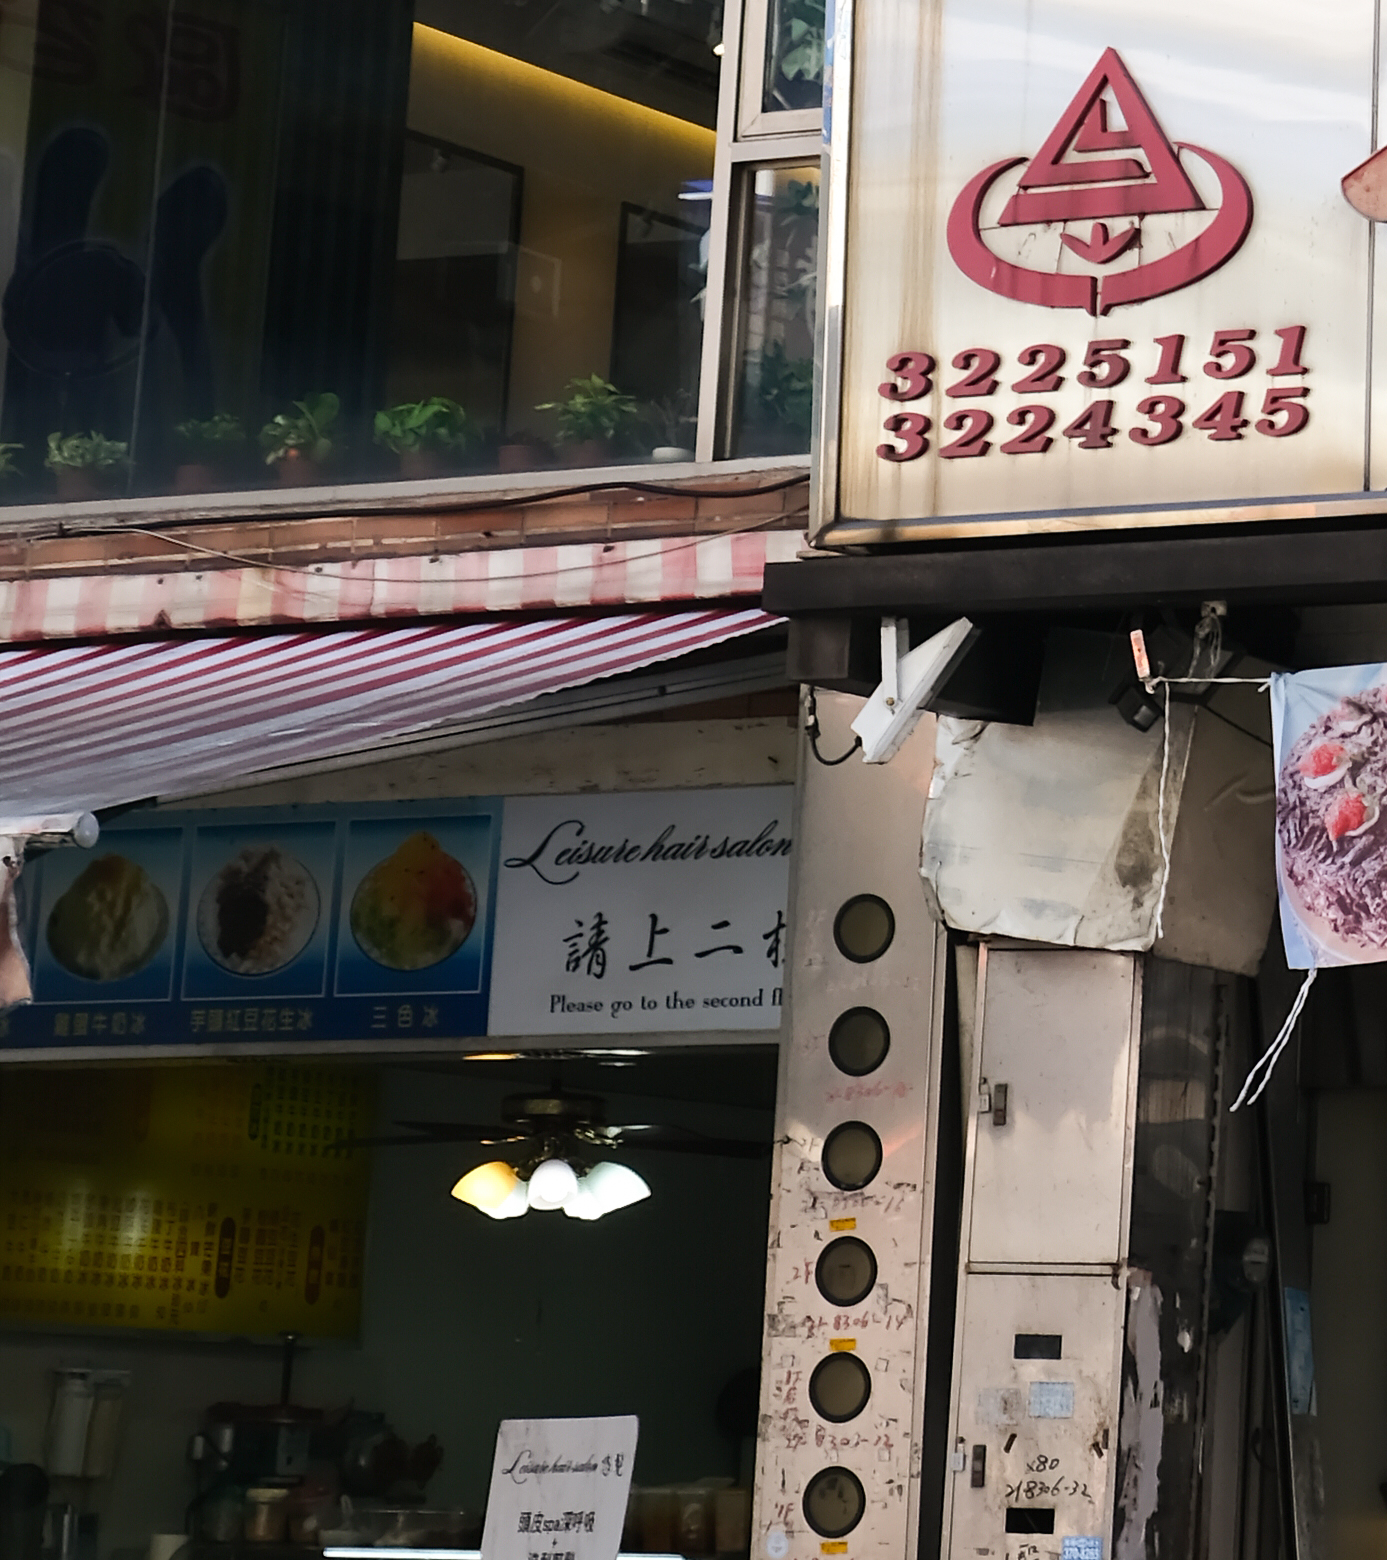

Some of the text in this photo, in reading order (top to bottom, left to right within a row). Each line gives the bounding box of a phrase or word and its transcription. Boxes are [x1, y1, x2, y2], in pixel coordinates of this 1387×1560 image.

[878, 324, 1308, 401] 3225151
[876, 385, 1310, 462] 3224345
[504, 819, 642, 885] Leisure
[370, 1003, 440, 1029] 三色冰
[549, 993, 604, 1014] Please
[611, 997, 633, 1019] go
[641, 995, 658, 1010] to
[666, 991, 695, 1009] the
[702, 987, 764, 1008] second
